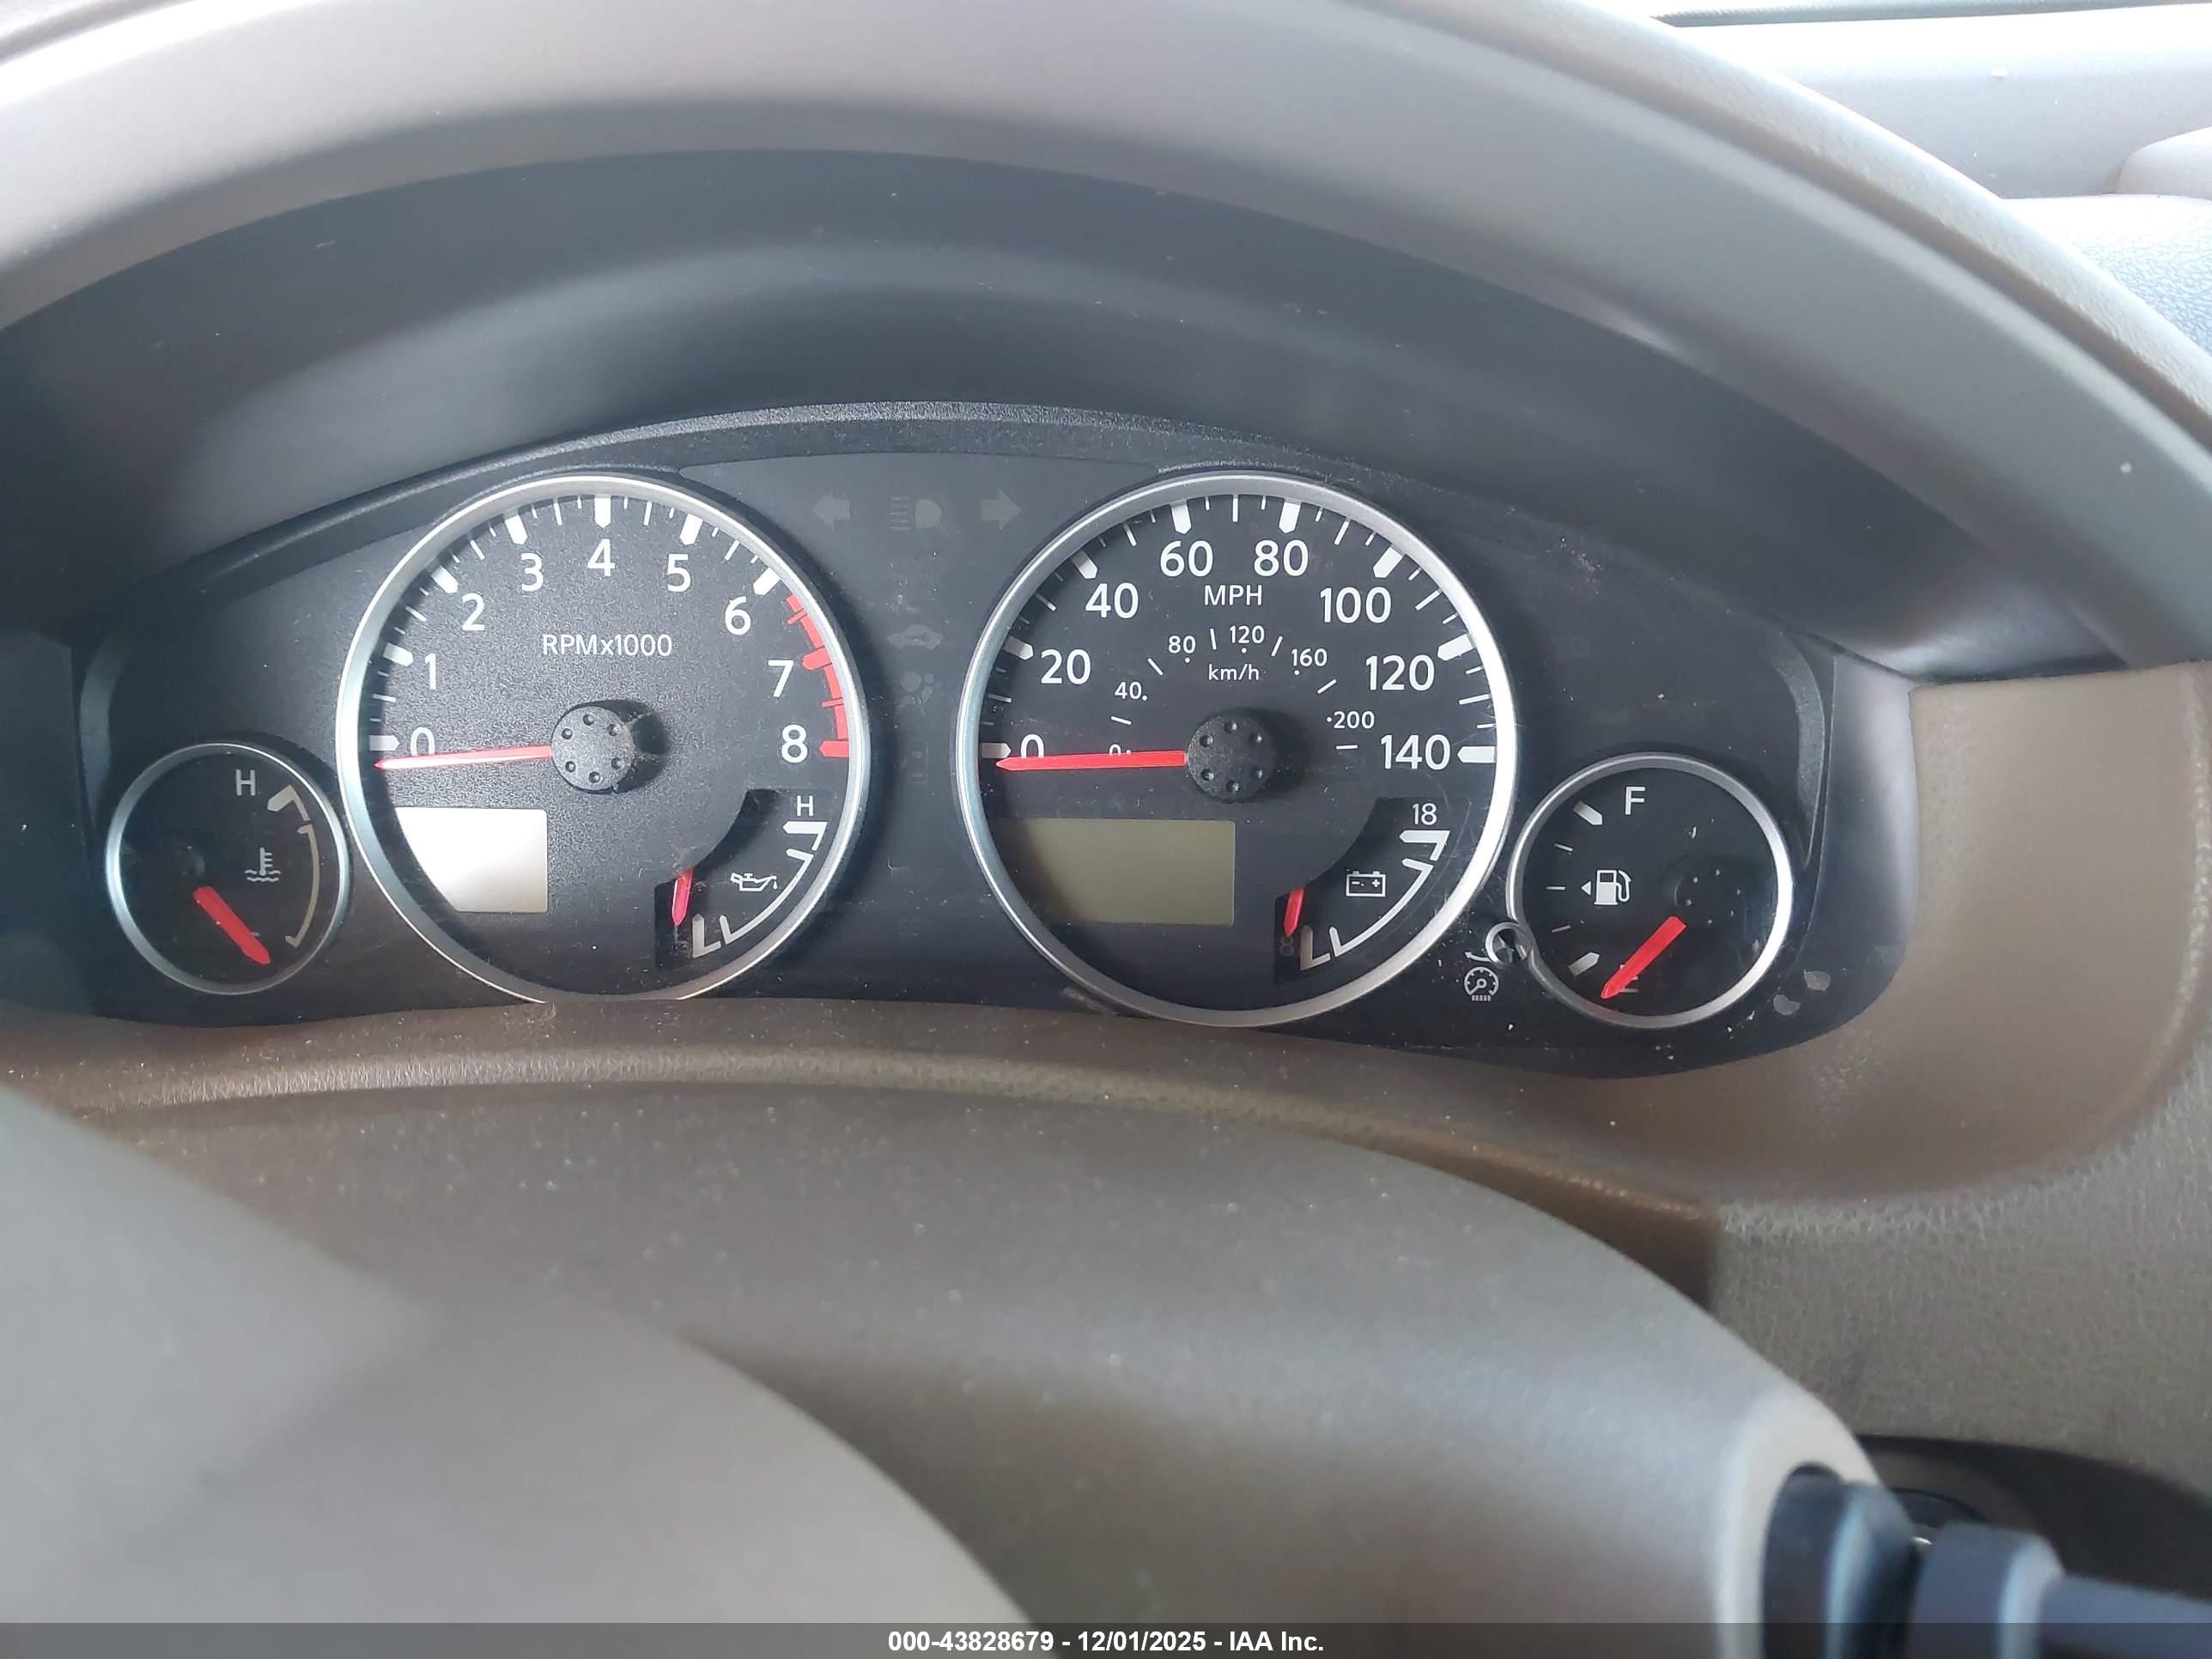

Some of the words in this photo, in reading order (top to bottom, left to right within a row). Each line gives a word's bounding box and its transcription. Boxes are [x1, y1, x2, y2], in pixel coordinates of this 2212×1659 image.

[521, 552, 544, 592] 3
[587, 539, 616, 577] 4
[666, 553, 691, 592] 5
[1160, 540, 1213, 577] 60
[1254, 540, 1309, 577] 80
[462, 593, 486, 631] 2
[1085, 582, 1139, 619] 40
[1204, 584, 1262, 605] MPH
[1320, 586, 1391, 623] 100
[725, 596, 751, 635] 6
[541, 633, 672, 657] RPMx1000
[1168, 635, 1196, 654] 80
[1230, 625, 1265, 644] 120
[425, 653, 437, 690] 1
[1041, 648, 1091, 684] 20
[1208, 663, 1260, 681] km/h
[1291, 647, 1328, 667] 160
[1365, 654, 1435, 691] 120
[768, 659, 794, 697] 7
[1114, 681, 1142, 700] 40
[1334, 710, 1375, 729] 200
[410, 726, 436, 756] 0
[781, 724, 808, 763] 8
[1020, 733, 1044, 758] 0
[1381, 734, 1450, 770] 140
[235, 769, 256, 797] H
[1625, 786, 1646, 815] F
[796, 795, 814, 817] H
[1412, 802, 1437, 826] 18
